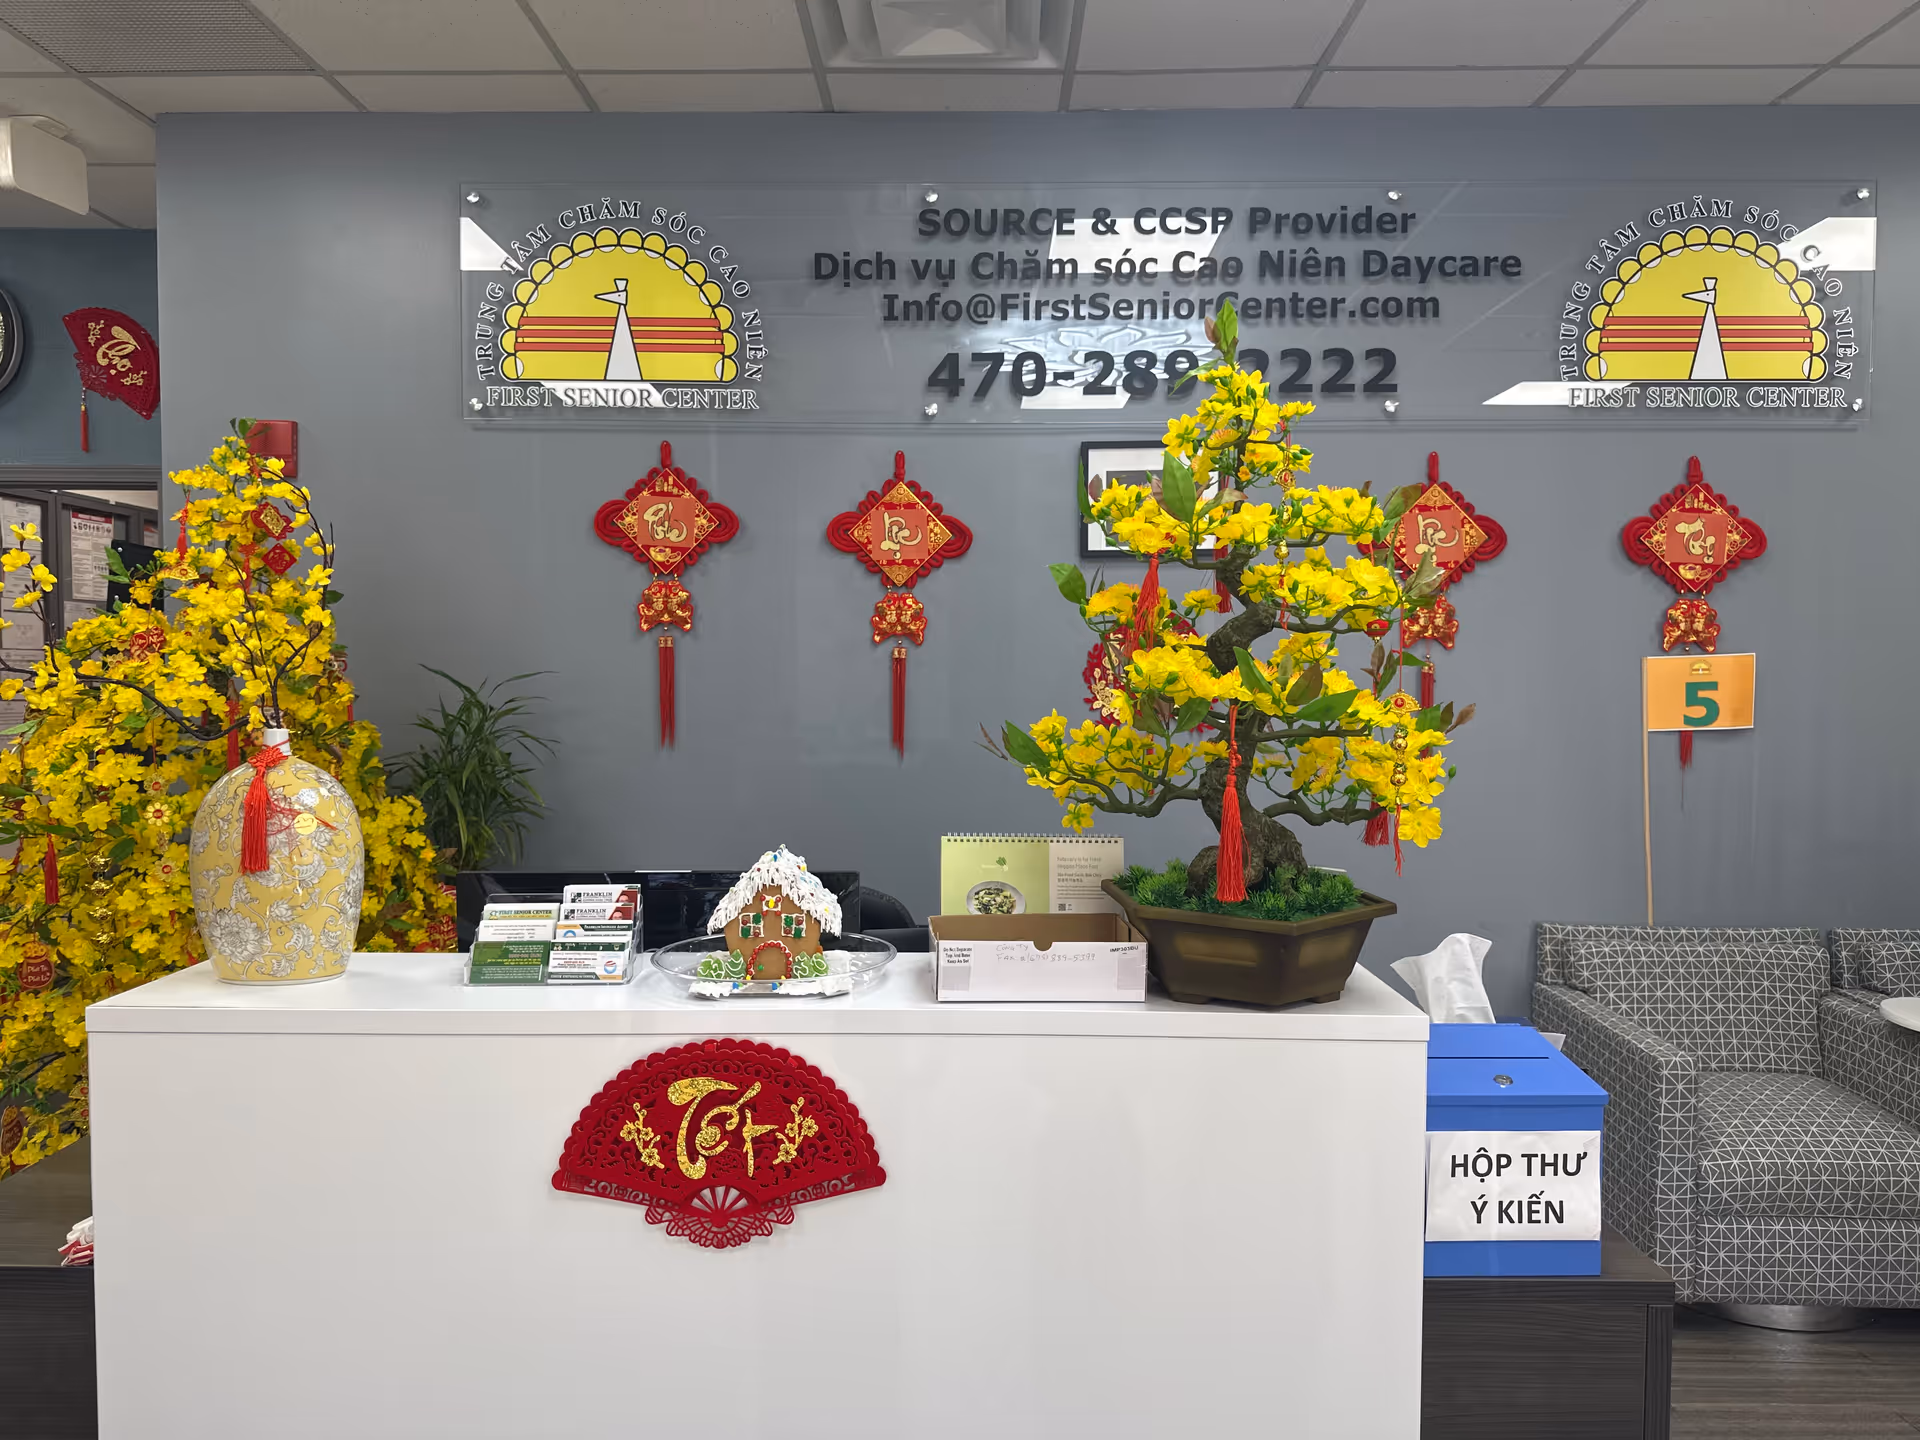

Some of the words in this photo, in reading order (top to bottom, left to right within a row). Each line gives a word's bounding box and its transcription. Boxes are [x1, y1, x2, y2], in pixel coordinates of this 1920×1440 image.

[918, 207, 1076, 237] SOURCE
[1091, 207, 1120, 236] &
[1133, 206, 1233, 235] CCSP
[1249, 205, 1416, 234] Provider
[813, 251, 896, 287] Dịch
[911, 258, 956, 287] vụ
[971, 249, 1078, 280] Chăm
[1094, 248, 1158, 280] sóc
[1172, 250, 1244, 279] Cao
[1258, 247, 1346, 278] Niên
[1362, 249, 1522, 283] Daycare
[476, 281, 505, 380] TRUNG
[500, 223, 552, 275] TÂM
[558, 197, 640, 229] CHĂM
[651, 207, 706, 244] SÓC
[708, 245, 751, 300] CAO
[741, 308, 769, 382] NIÊN
[1559, 281, 1591, 381] TRUNG
[1585, 221, 1640, 275] TÂM
[1648, 195, 1733, 228] CHĂM
[1744, 206, 1799, 244] SÓC
[1800, 245, 1843, 297] CAO
[1832, 306, 1859, 380] NIÊN
[883, 290, 1439, 324] Info@FirstSeniorCenter.com
[927, 347, 1398, 399] 470-289222
[486, 386, 556, 407] FIRST
[562, 387, 654, 409] SENIOR
[660, 387, 759, 410] CENTER
[1567, 387, 1639, 408] FIRST
[1646, 386, 1740, 408] SENIOR
[1745, 386, 1847, 408] CENTER
[1683, 681, 1720, 727] 5
[1450, 1147, 1512, 1183] HỘP
[1521, 1151, 1588, 1177] THƯ
[1470, 1194, 1488, 1224] Ý
[1498, 1190, 1564, 1224] KIẾN
